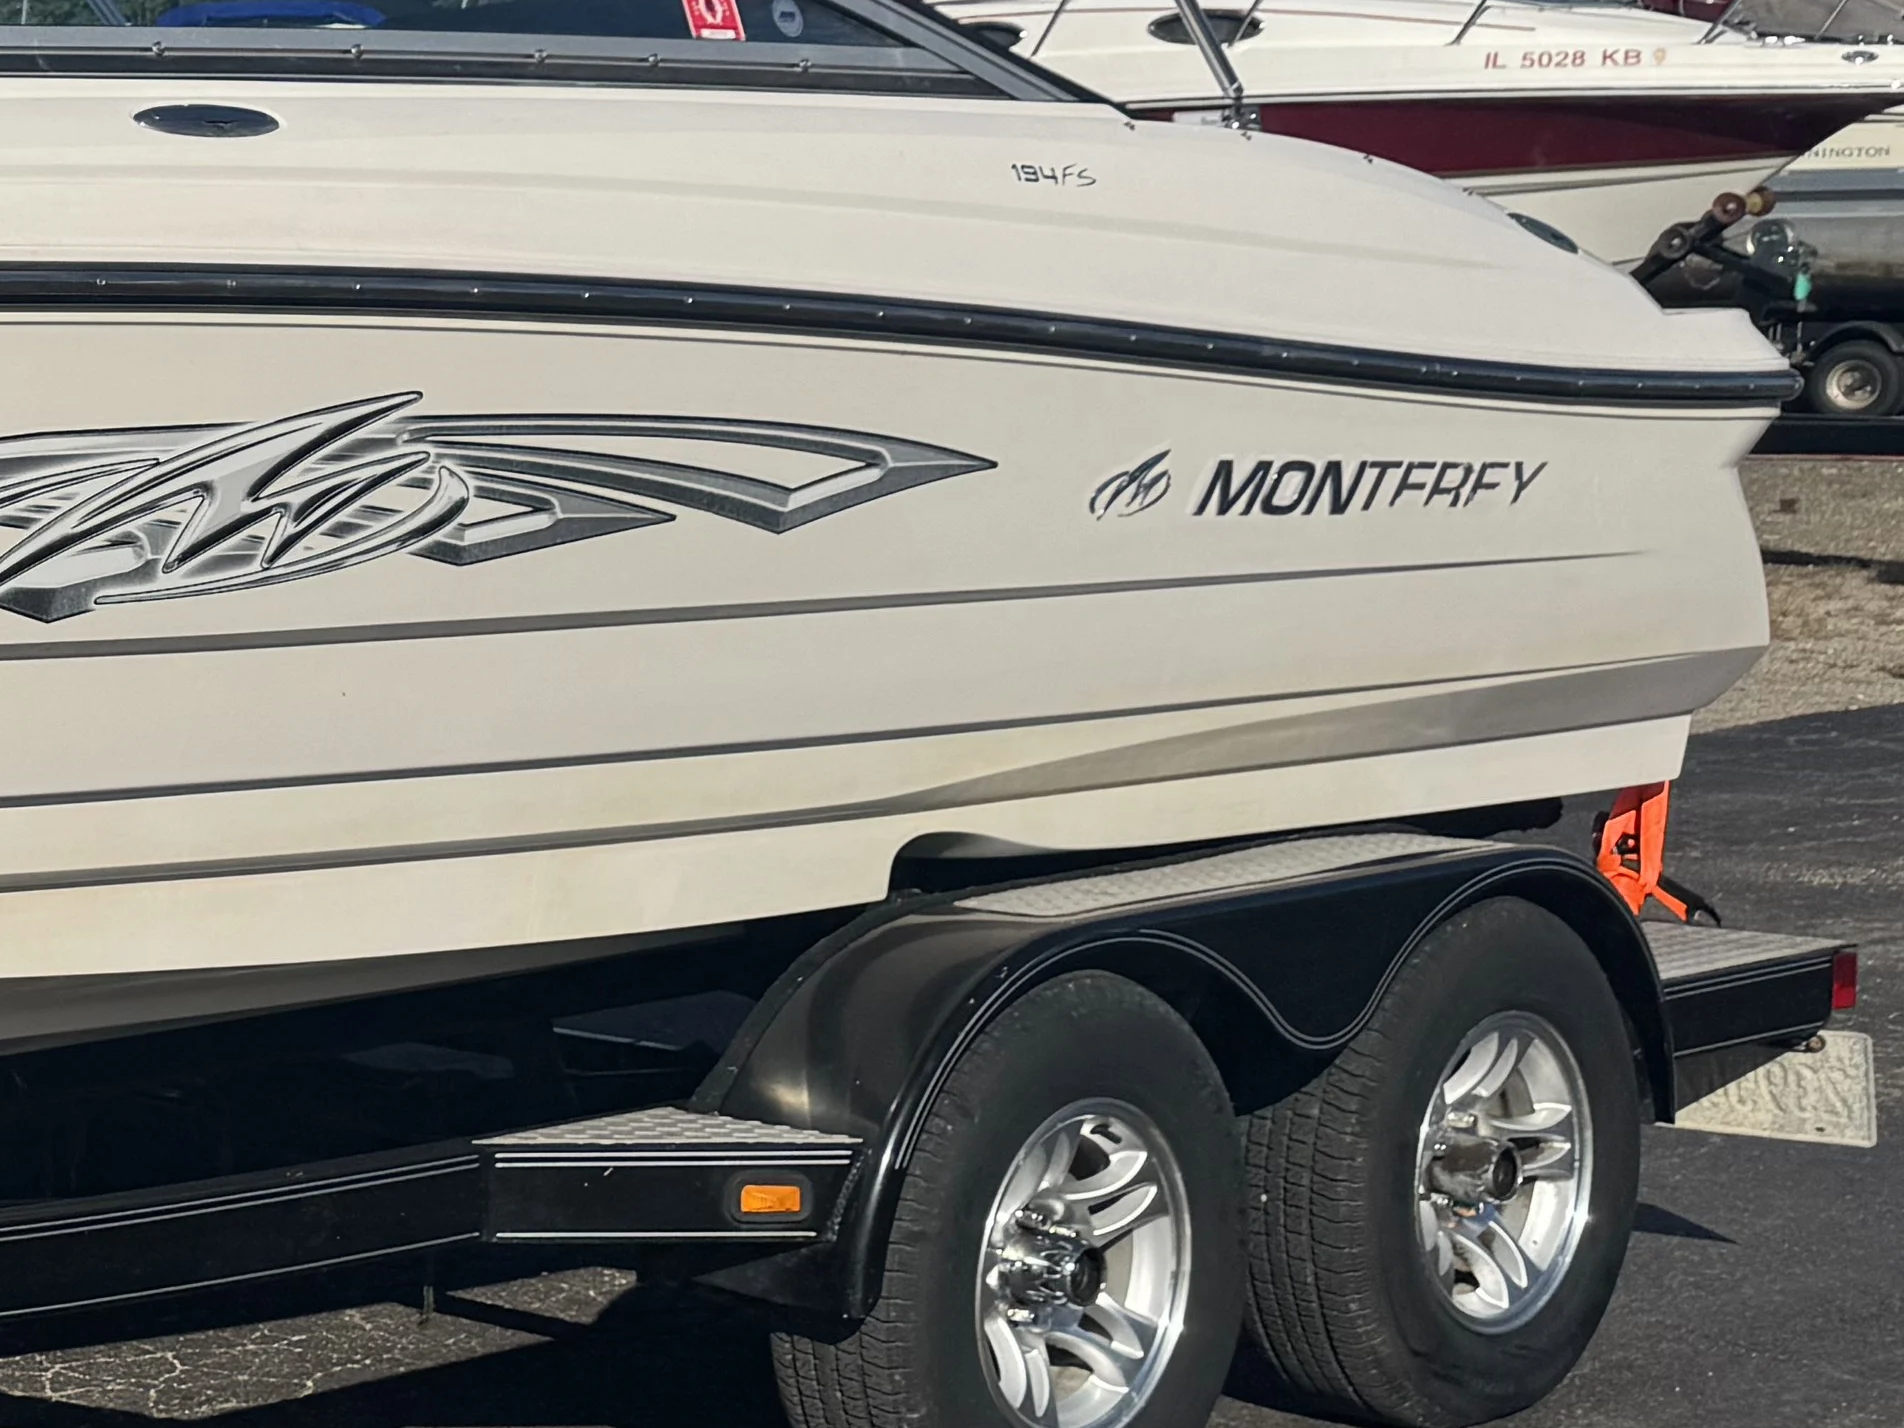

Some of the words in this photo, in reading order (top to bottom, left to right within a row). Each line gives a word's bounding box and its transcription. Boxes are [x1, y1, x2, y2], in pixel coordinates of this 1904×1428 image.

[1484, 51, 1507, 70] IL
[1520, 49, 1587, 69] 5028
[1601, 47, 1643, 67] KB
[1192, 458, 1550, 517] MONTEREY
